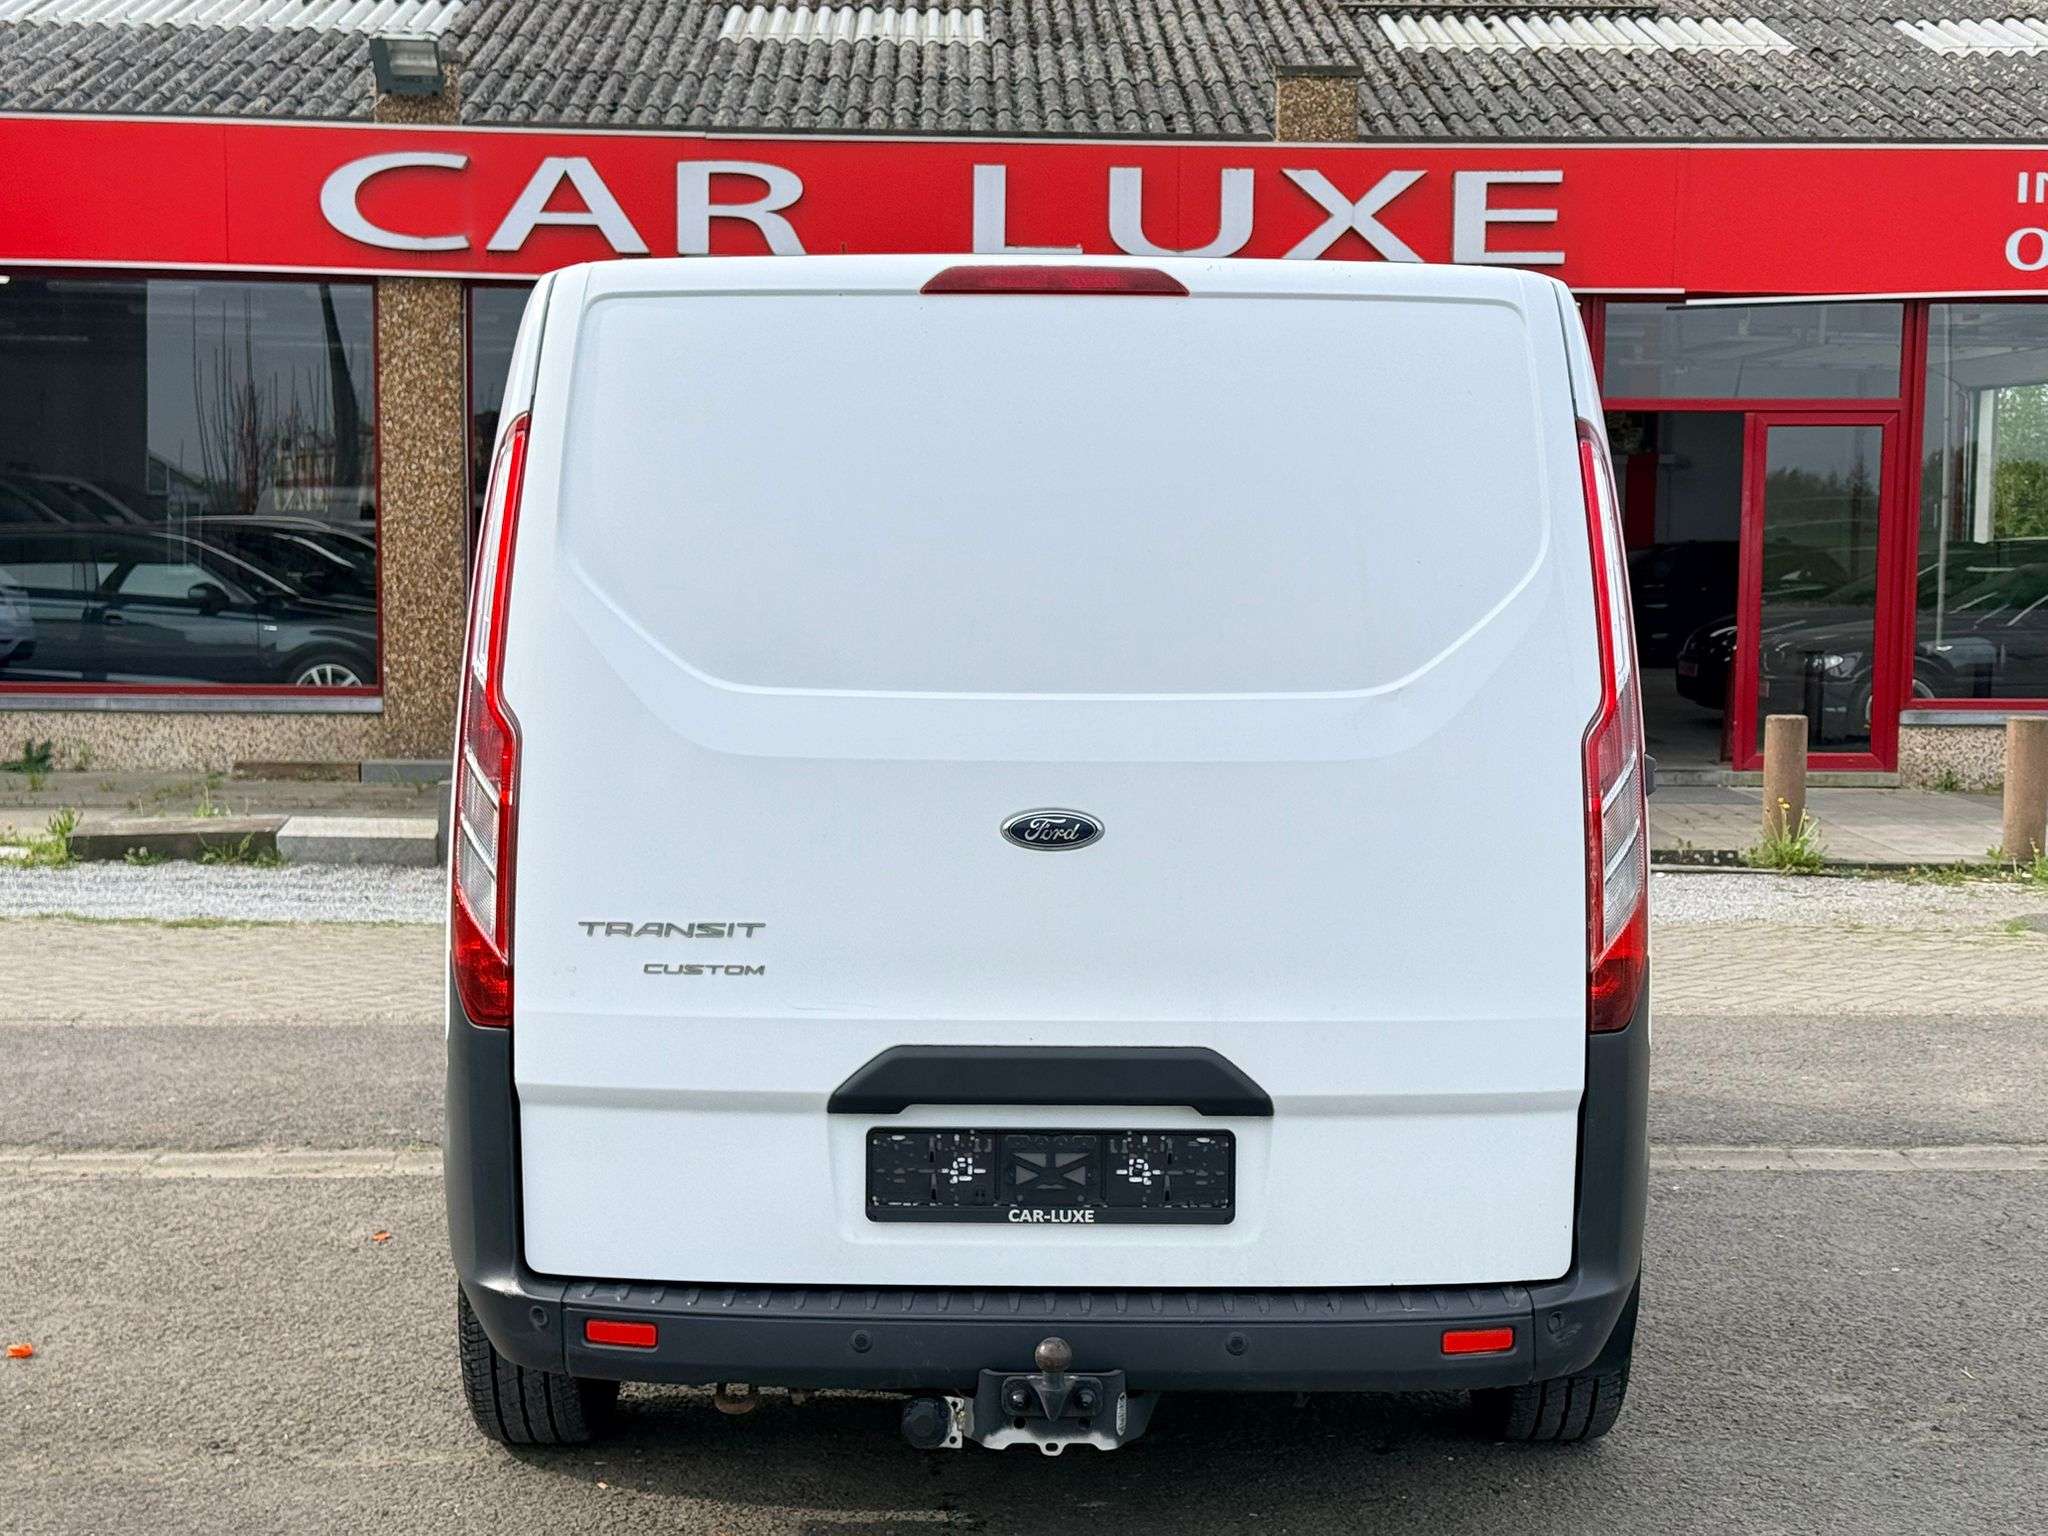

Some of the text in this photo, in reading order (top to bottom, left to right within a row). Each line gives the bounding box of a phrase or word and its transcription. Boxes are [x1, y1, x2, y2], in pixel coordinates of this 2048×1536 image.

[320, 151, 1565, 264] CAR LUXE
[1024, 818, 1080, 840] Ford
[578, 921, 766, 938] TRANSIT
[643, 963, 766, 976] CUSTOM
[1008, 1209, 1095, 1223] CAR-LUXE
